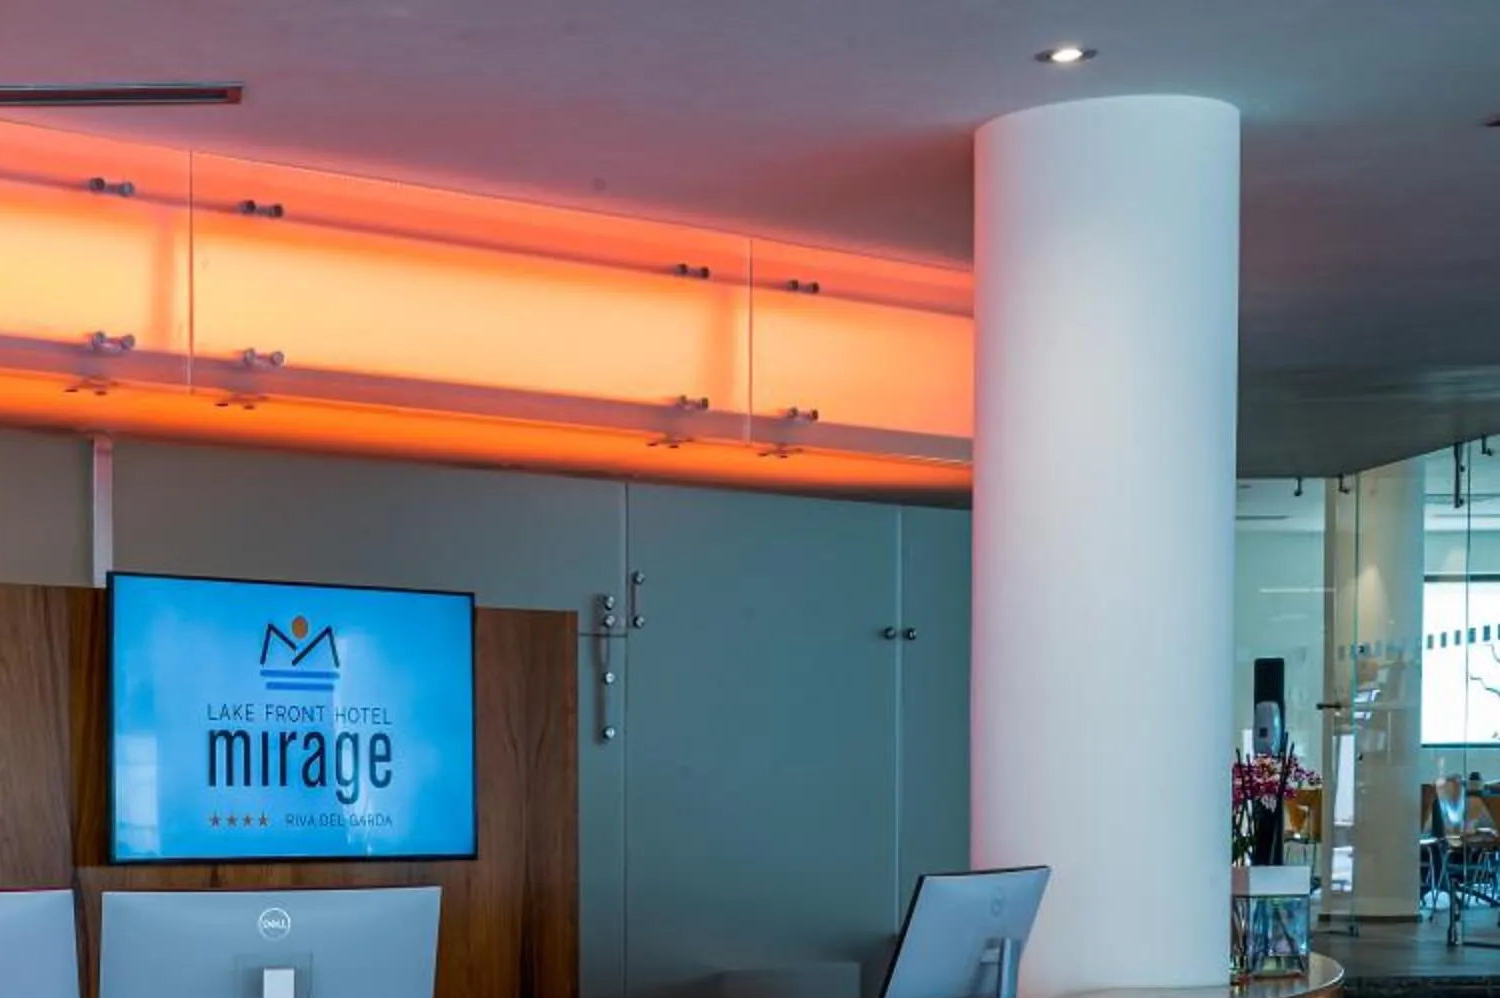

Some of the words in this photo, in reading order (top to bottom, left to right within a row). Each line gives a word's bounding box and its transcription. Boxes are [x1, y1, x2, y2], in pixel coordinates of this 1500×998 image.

[207, 704, 255, 722] LAKE
[265, 704, 325, 723] FRONT
[335, 707, 392, 725] HOTEL
[208, 729, 392, 804] mirage
[285, 813, 315, 827] RIVA
[320, 813, 344, 827] DEL
[349, 813, 393, 827] GARDA
